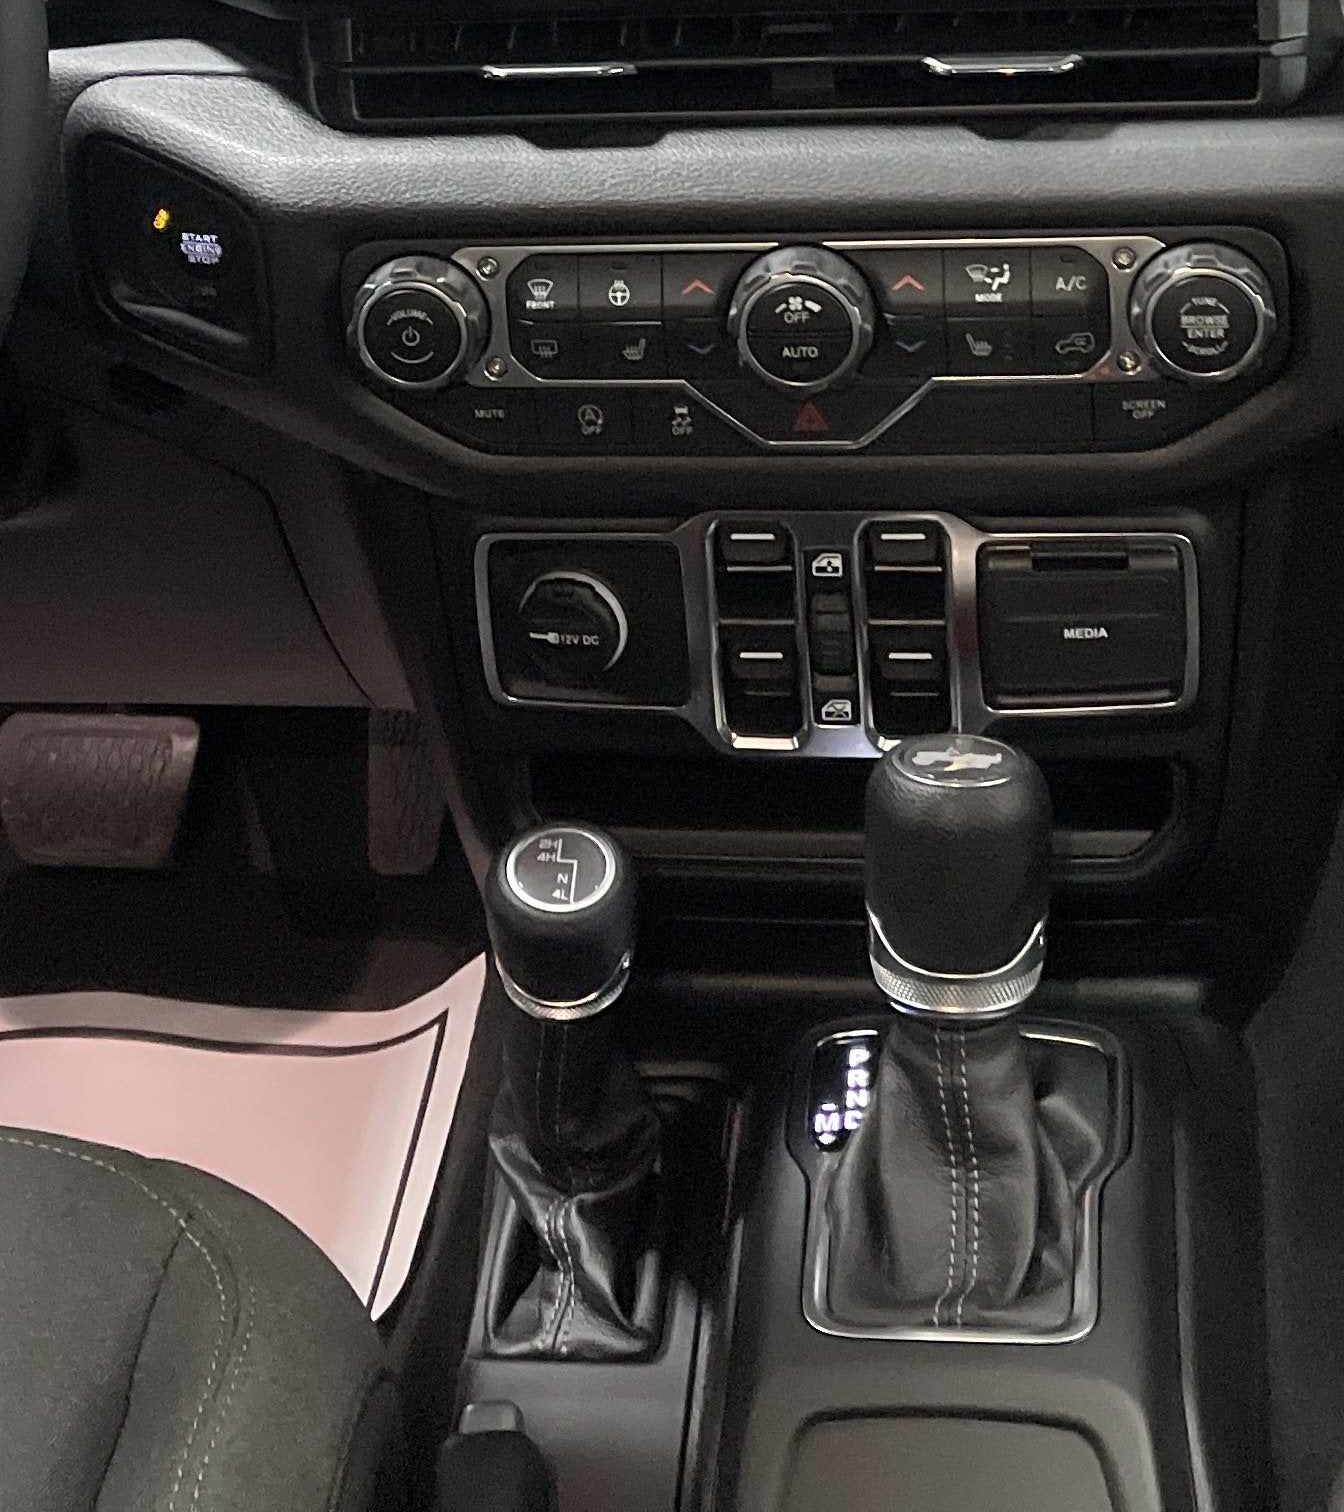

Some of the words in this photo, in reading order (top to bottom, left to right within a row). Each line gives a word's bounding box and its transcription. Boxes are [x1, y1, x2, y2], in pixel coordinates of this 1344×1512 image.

[181, 231, 219, 245] START
[1055, 275, 1088, 292] A/C
[974, 292, 1004, 304] MODE
[525, 299, 555, 311] FRONT
[392, 309, 429, 322] VOLUME
[784, 311, 810, 325] OFF
[1180, 314, 1229, 326] BROWSE
[1186, 327, 1225, 339] ENTER
[782, 345, 819, 360] AUTO
[1121, 399, 1166, 411] SCREEN
[473, 408, 506, 420] MUTE
[580, 423, 604, 436] OFF
[670, 423, 694, 436] OFF
[1063, 626, 1109, 640] MEDIA
[582, 635, 600, 646] DC
[536, 851, 557, 863] 4H
[557, 872, 569, 884] N
[551, 888, 569, 900] 4L
[848, 1047, 871, 1067] P
[846, 1068, 871, 1088] R
[845, 1089, 870, 1109] N
[814, 1112, 840, 1133] M
